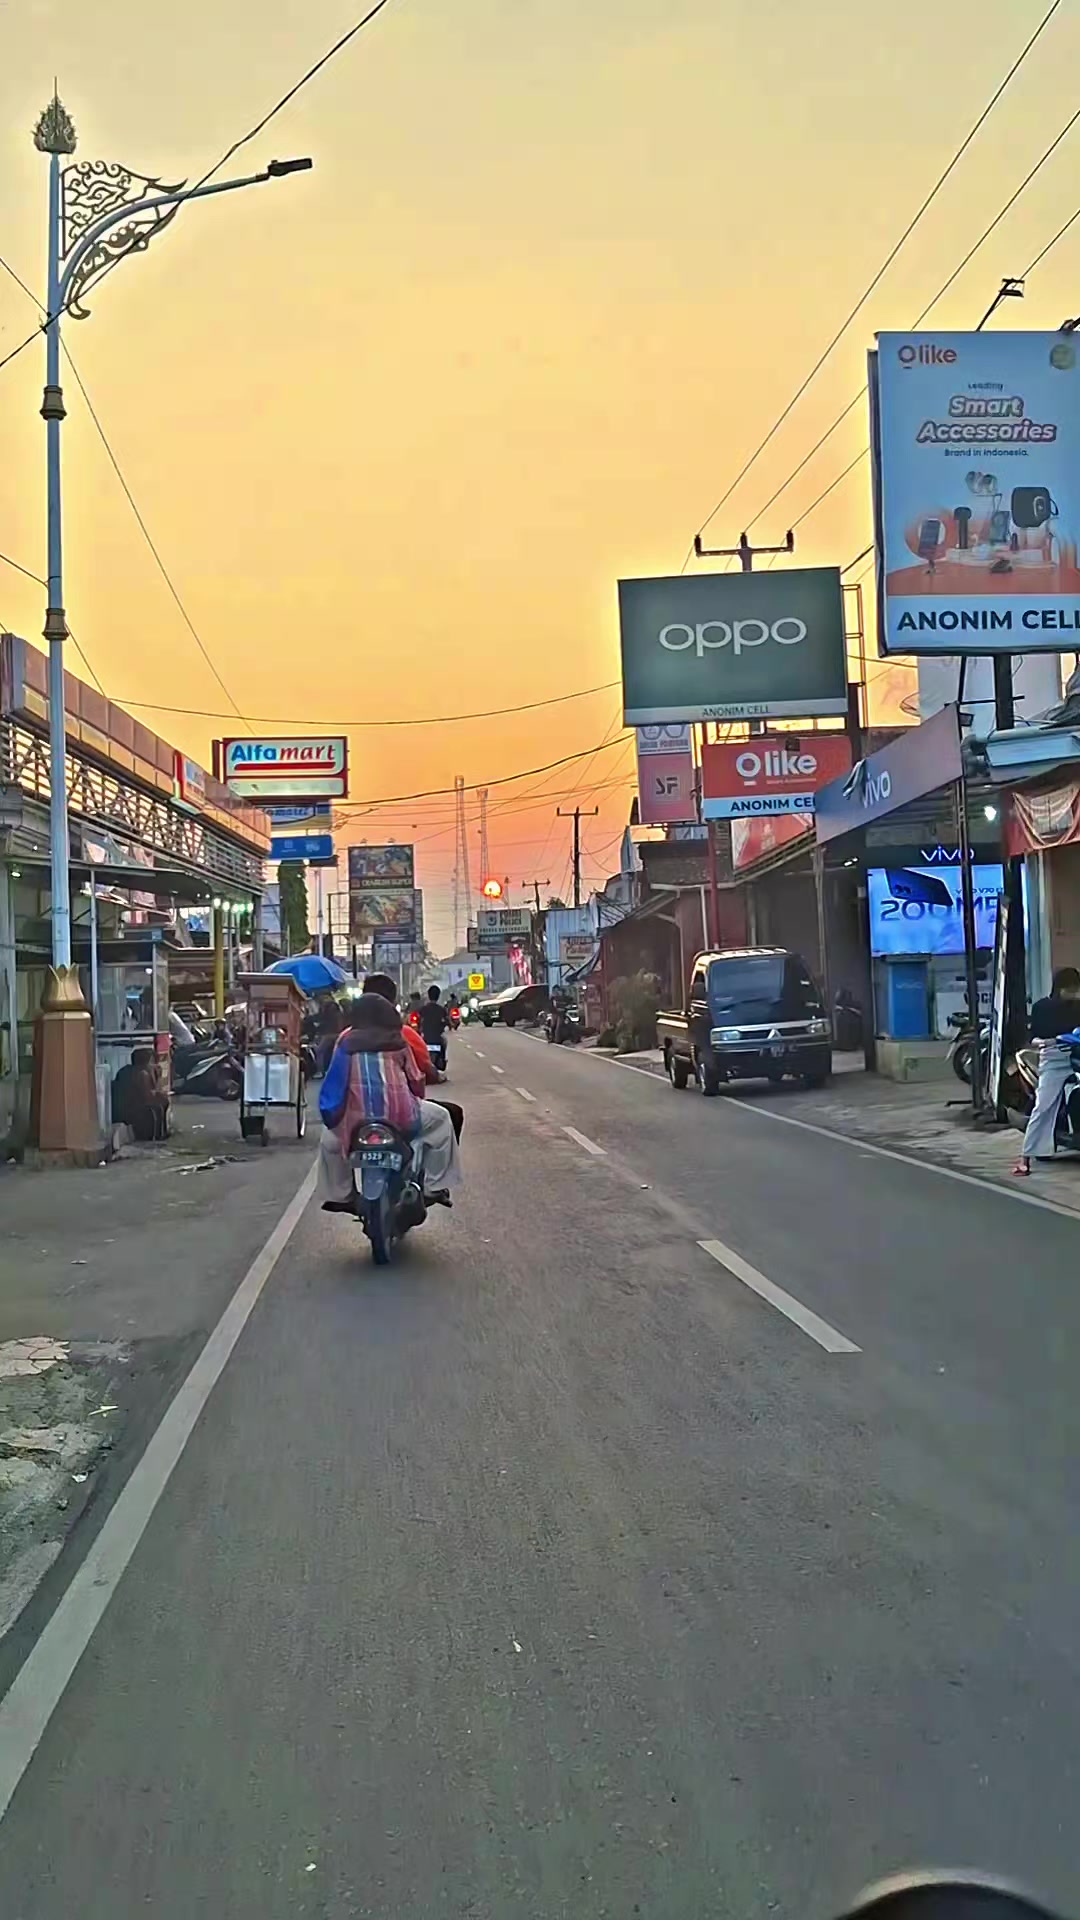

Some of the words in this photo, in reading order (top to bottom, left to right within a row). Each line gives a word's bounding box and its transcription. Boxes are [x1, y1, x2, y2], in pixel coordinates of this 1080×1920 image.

[897, 344, 957, 367] Olike
[950, 396, 1022, 416] Smart
[917, 420, 1055, 441] Accessories
[944, 448, 971, 457] Brand
[897, 610, 1013, 631] ANONIM
[658, 616, 808, 657] oppo
[702, 706, 745, 717] ANONIM
[746, 704, 771, 714] CELL
[231, 743, 336, 761] Alfamart
[736, 750, 817, 786] Olike
[730, 798, 789, 812] ANONIM
